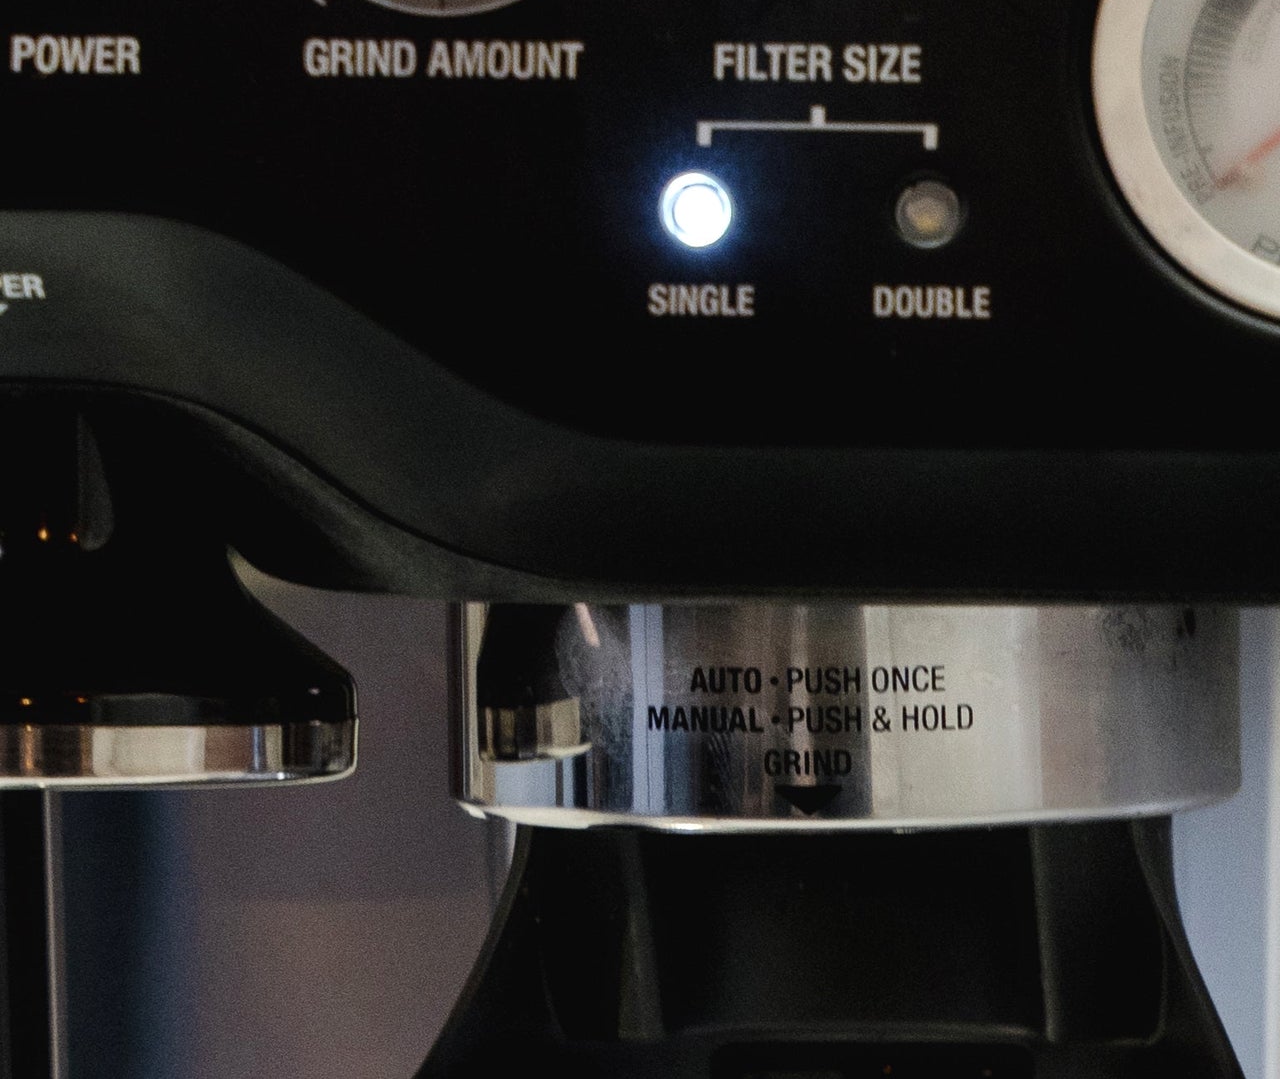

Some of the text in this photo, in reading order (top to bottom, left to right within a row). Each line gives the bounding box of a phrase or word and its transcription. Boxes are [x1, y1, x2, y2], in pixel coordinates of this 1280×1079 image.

[11, 35, 140, 74] POWER
[304, 38, 584, 79] GRIND AMOUNT
[714, 43, 921, 83] FILTER SIZE
[649, 284, 754, 317] SINGLE
[873, 286, 990, 318] DOUBLE
[690, 665, 945, 694] AUTO PUSH ONCE
[647, 704, 974, 733] MANUAL PUSH & HOLD
[764, 749, 852, 777] GRIND
